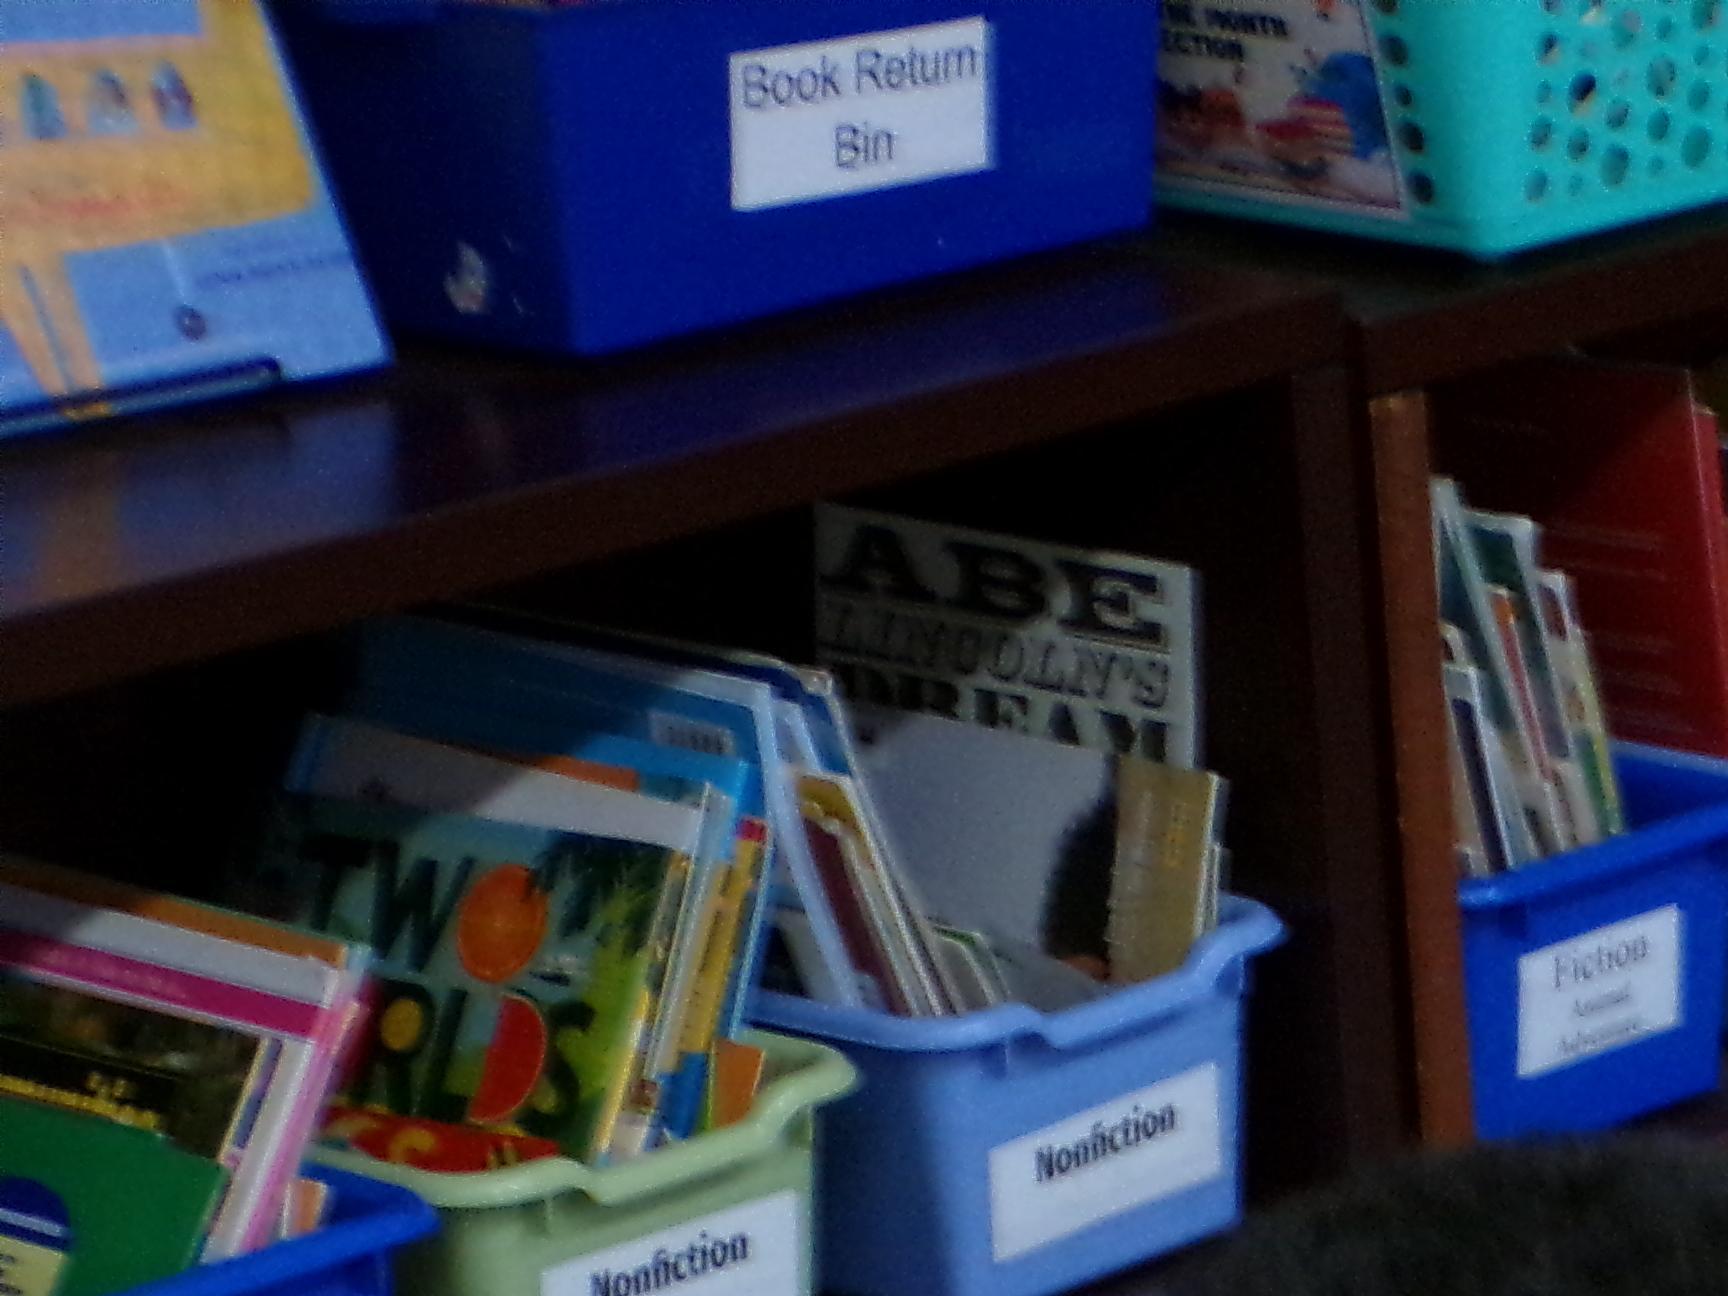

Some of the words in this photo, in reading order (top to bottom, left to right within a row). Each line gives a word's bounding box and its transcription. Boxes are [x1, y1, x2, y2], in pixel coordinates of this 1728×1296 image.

[741, 56, 839, 110] Book
[853, 41, 978, 94] Return
[832, 121, 897, 171] Bin
[820, 524, 1168, 644] ABE
[1552, 935, 1649, 989] Fiction
[1034, 1098, 1177, 1186] Nonfiction
